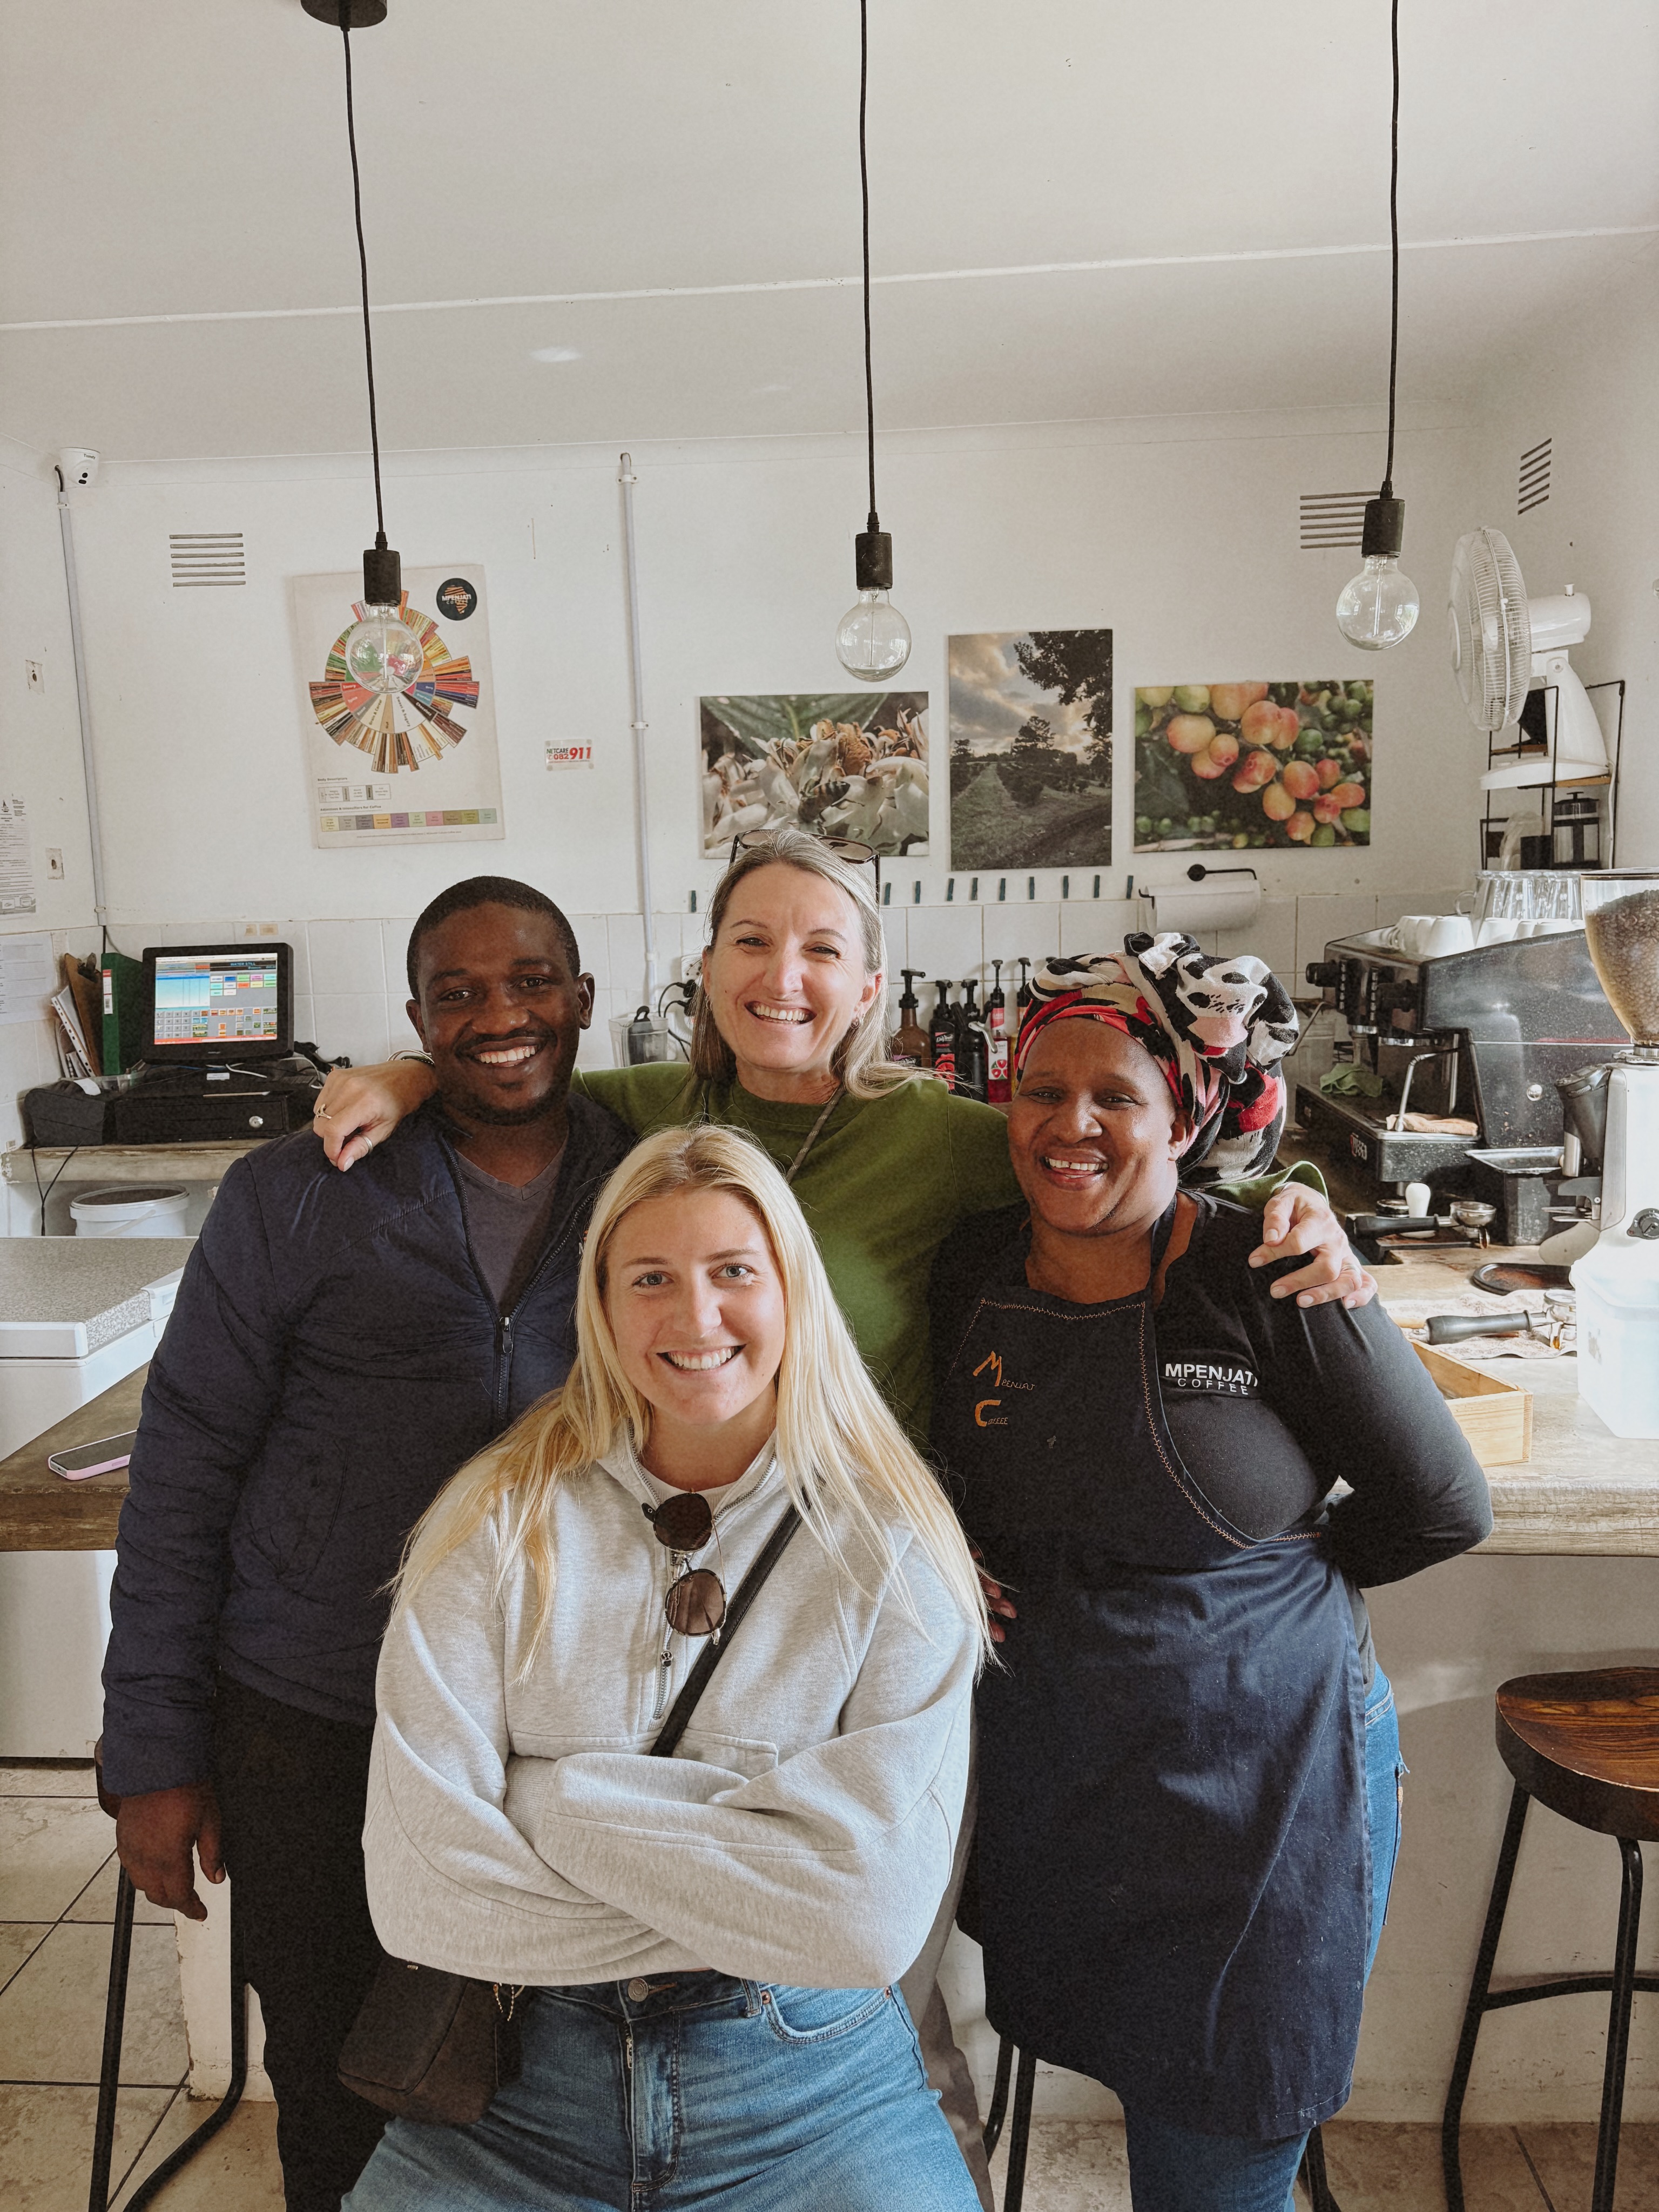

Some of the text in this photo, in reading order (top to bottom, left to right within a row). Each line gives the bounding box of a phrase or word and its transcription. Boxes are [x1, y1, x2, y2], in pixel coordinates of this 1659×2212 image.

[415, 702, 432, 717] Chocolate
[569, 746, 592, 760] 911
[1165, 1363, 1259, 1387] MPENJATI
[1177, 1378, 1249, 1395] COFFEE
